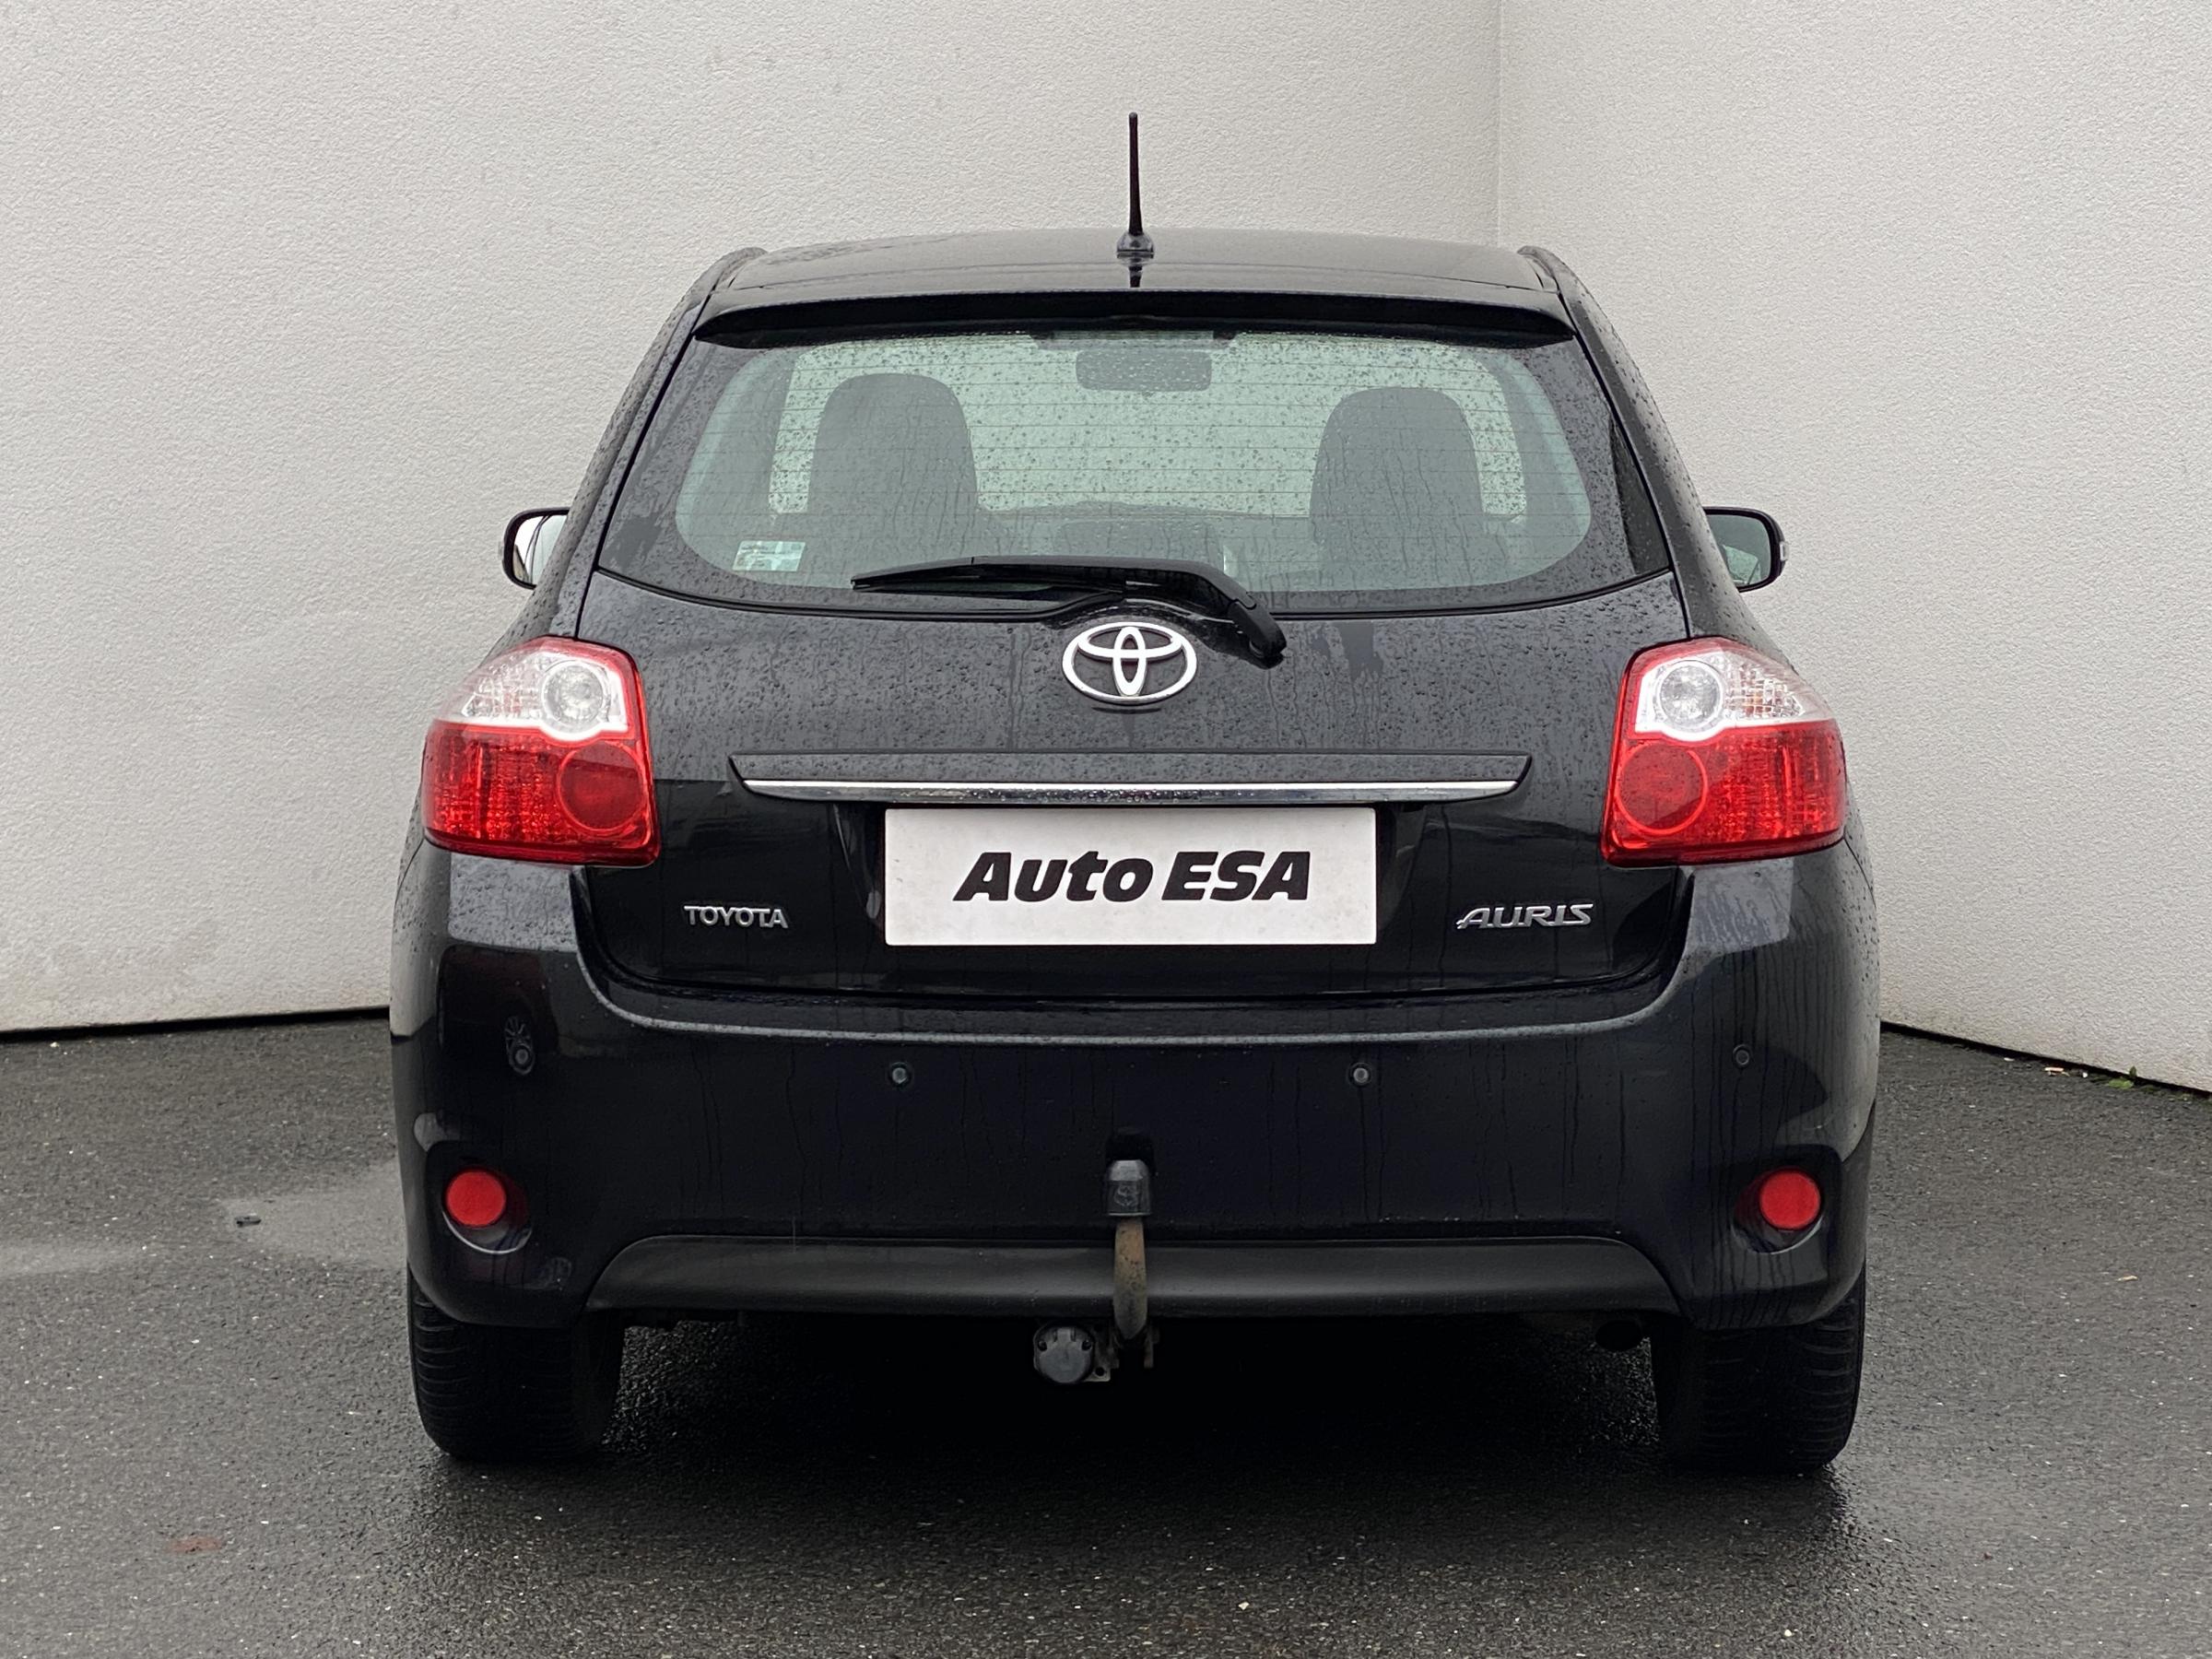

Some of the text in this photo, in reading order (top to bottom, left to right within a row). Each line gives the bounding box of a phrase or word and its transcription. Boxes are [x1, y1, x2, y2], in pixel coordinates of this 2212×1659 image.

[953, 851, 1311, 902] Auto ESA
[684, 905, 789, 928] TOYOTA
[1455, 903, 1594, 929] AURIS
